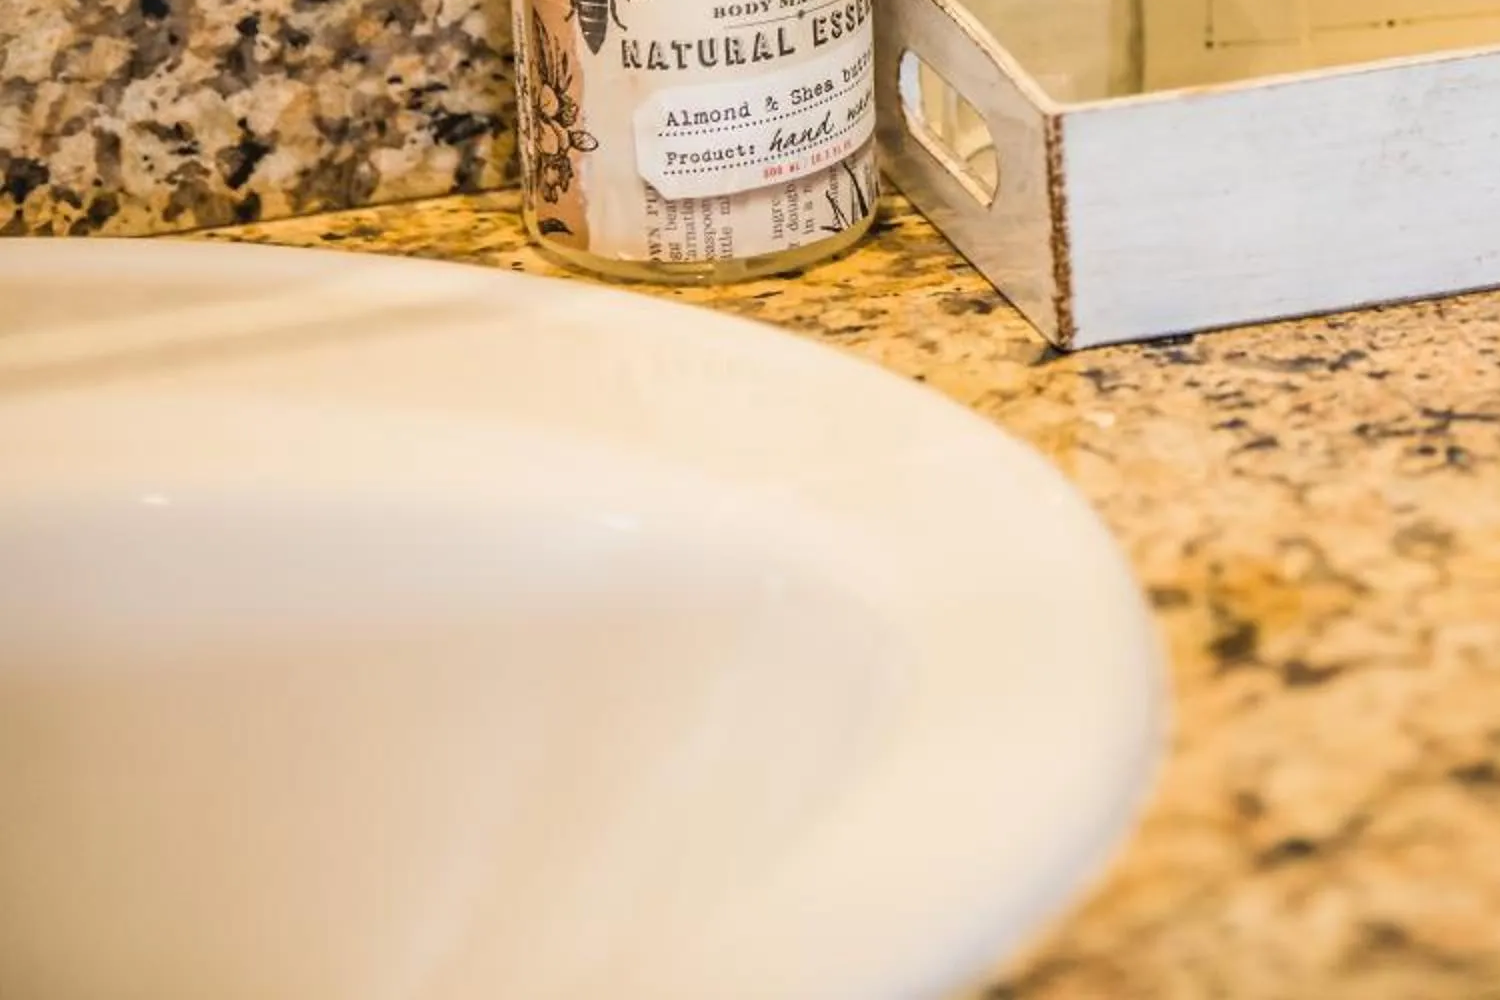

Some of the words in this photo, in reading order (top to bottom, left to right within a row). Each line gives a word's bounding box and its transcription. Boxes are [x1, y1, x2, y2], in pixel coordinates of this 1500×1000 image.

[712, 0, 772, 19] BODY
[620, 26, 796, 70] NATURAL
[666, 101, 751, 127] Almond
[789, 79, 834, 105] Shea
[665, 144, 756, 166] Product:
[769, 109, 835, 153] hand
